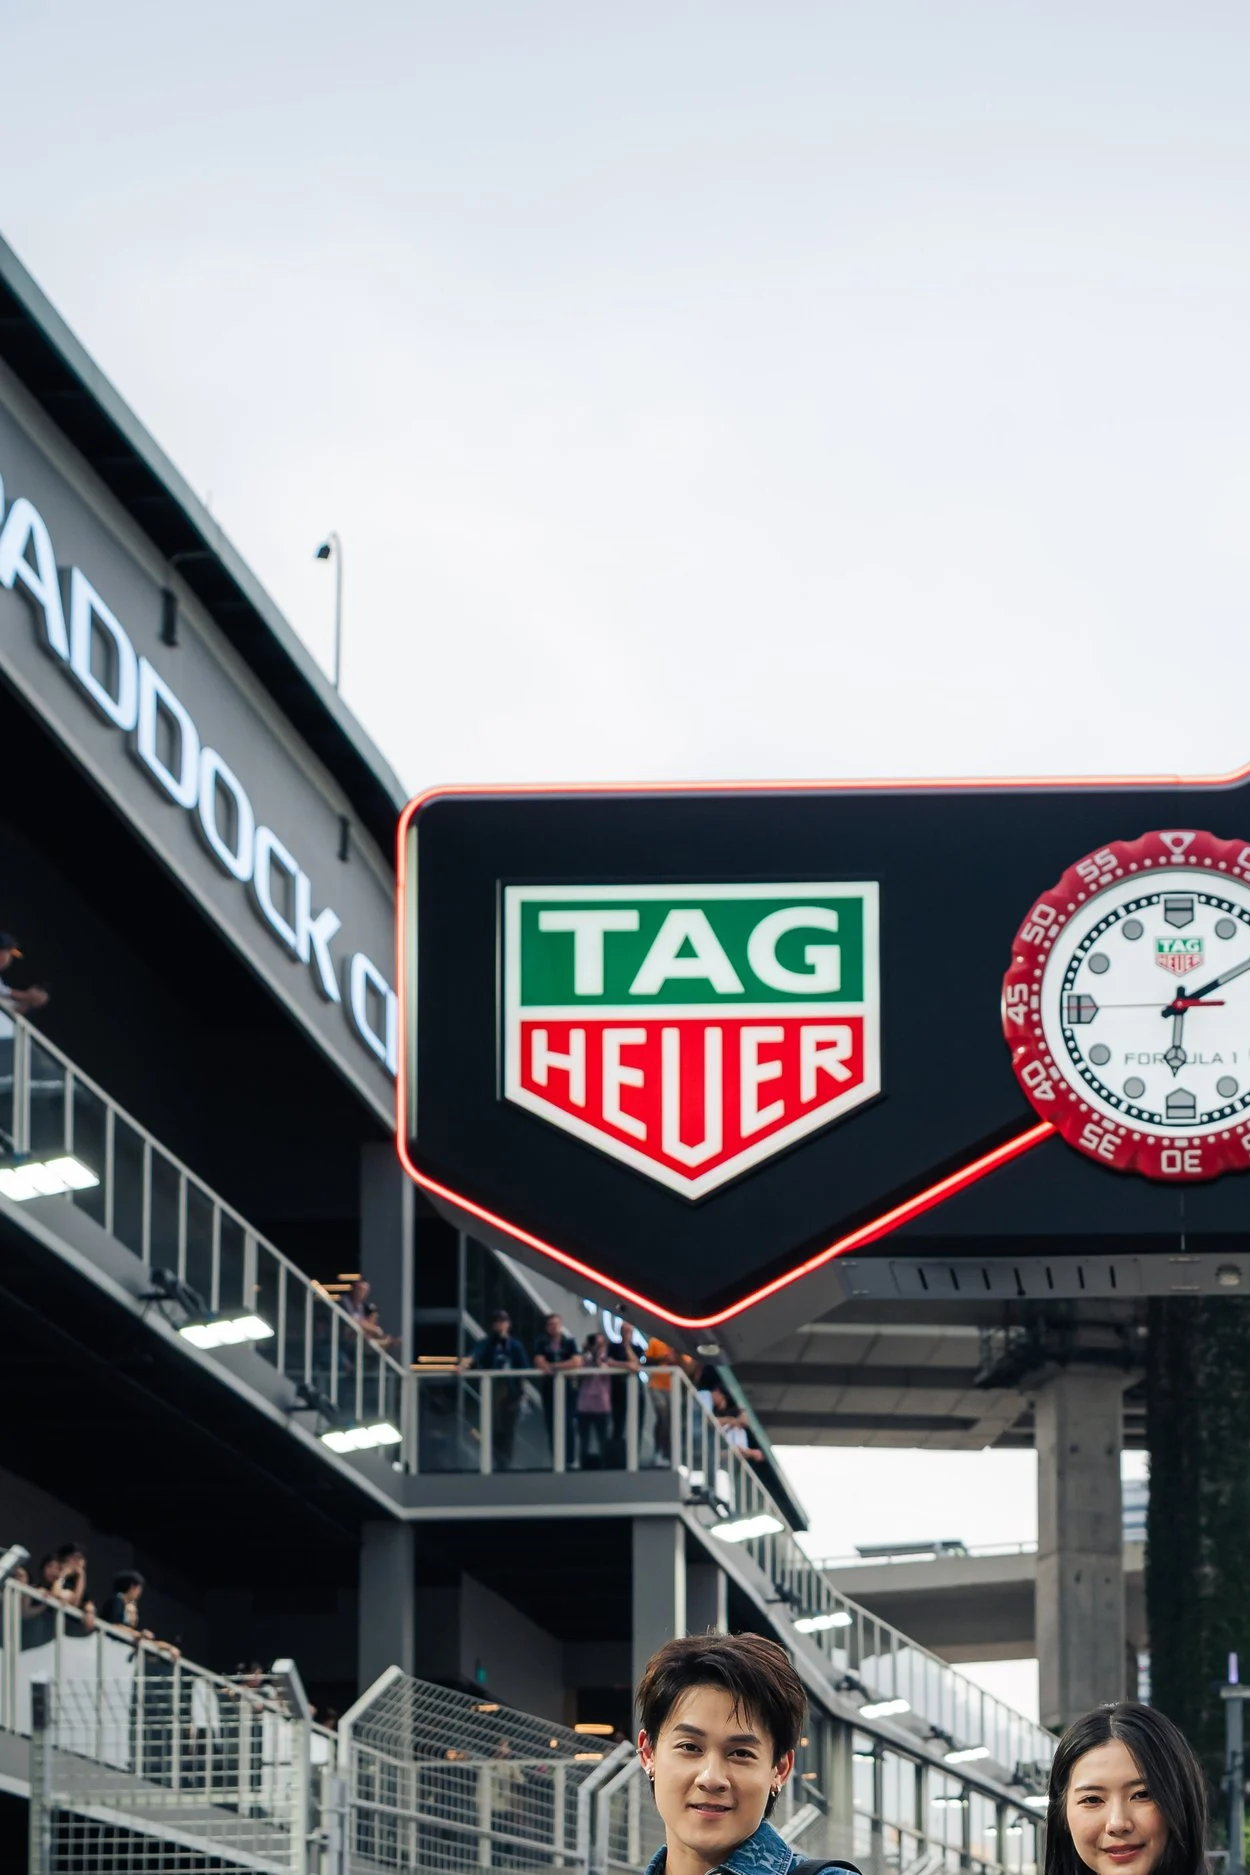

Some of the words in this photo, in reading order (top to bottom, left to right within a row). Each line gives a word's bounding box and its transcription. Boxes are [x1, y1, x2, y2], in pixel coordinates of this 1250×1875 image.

[0, 473, 341, 1003] ADDOCK
[1075, 848, 1118, 884] 55
[1021, 904, 1056, 943] 50
[538, 906, 842, 995] TAG
[1159, 939, 1200, 952] TAG
[1006, 983, 1029, 1026] 45
[1124, 1052, 1224, 1065] FORULA
[531, 1025, 853, 1168] HEUER
[1021, 1060, 1055, 1101] 40
[1079, 1123, 1122, 1160] 35
[1161, 1150, 1203, 1173] 30
